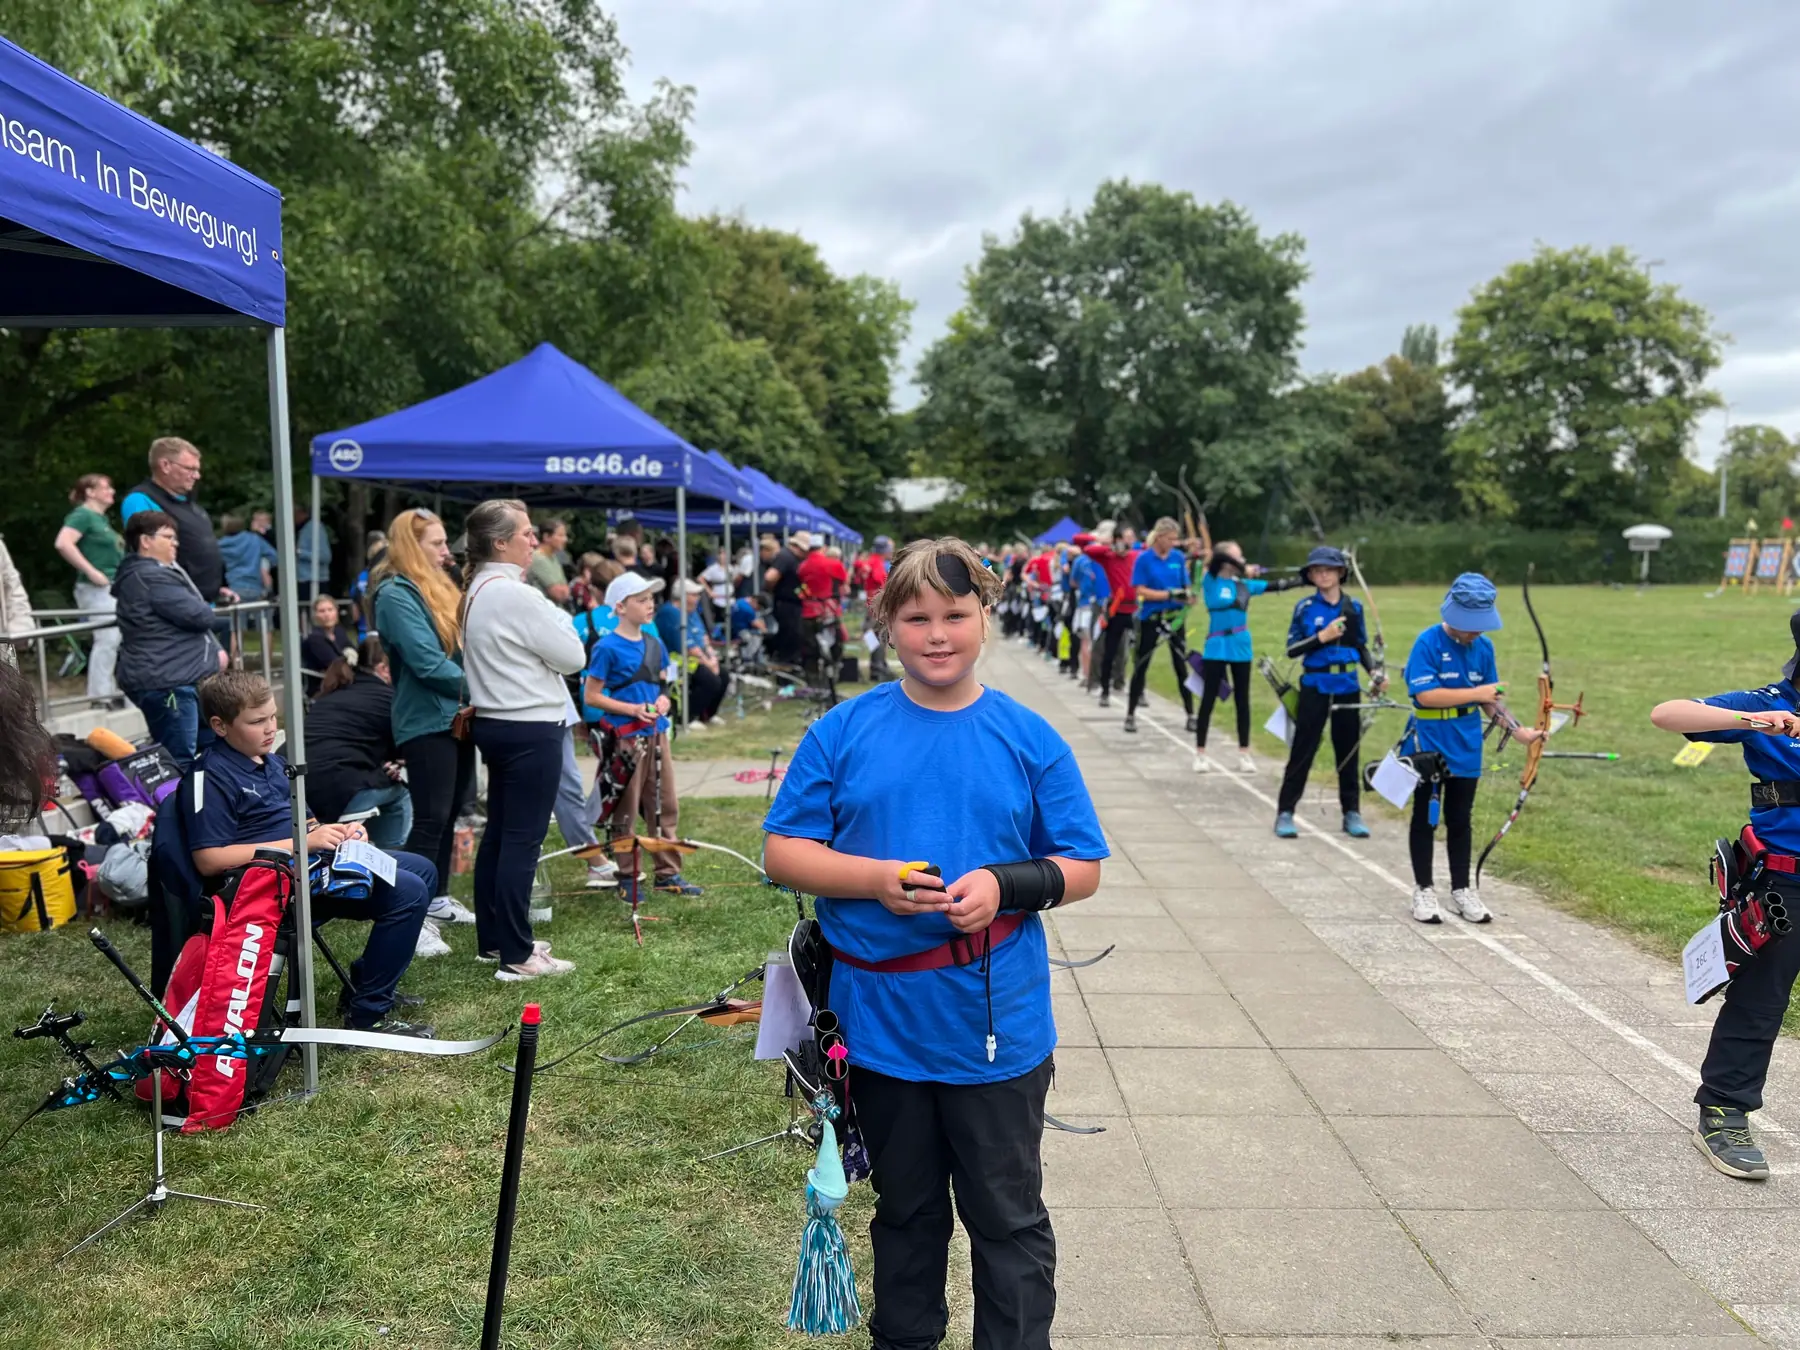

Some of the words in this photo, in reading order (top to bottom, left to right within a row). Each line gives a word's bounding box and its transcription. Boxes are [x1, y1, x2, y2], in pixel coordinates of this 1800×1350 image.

[96, 149, 122, 200] In
[129, 166, 260, 267] Bewegung!
[544, 453, 664, 478] asc46.de
[215, 923, 264, 1079] AVALON
